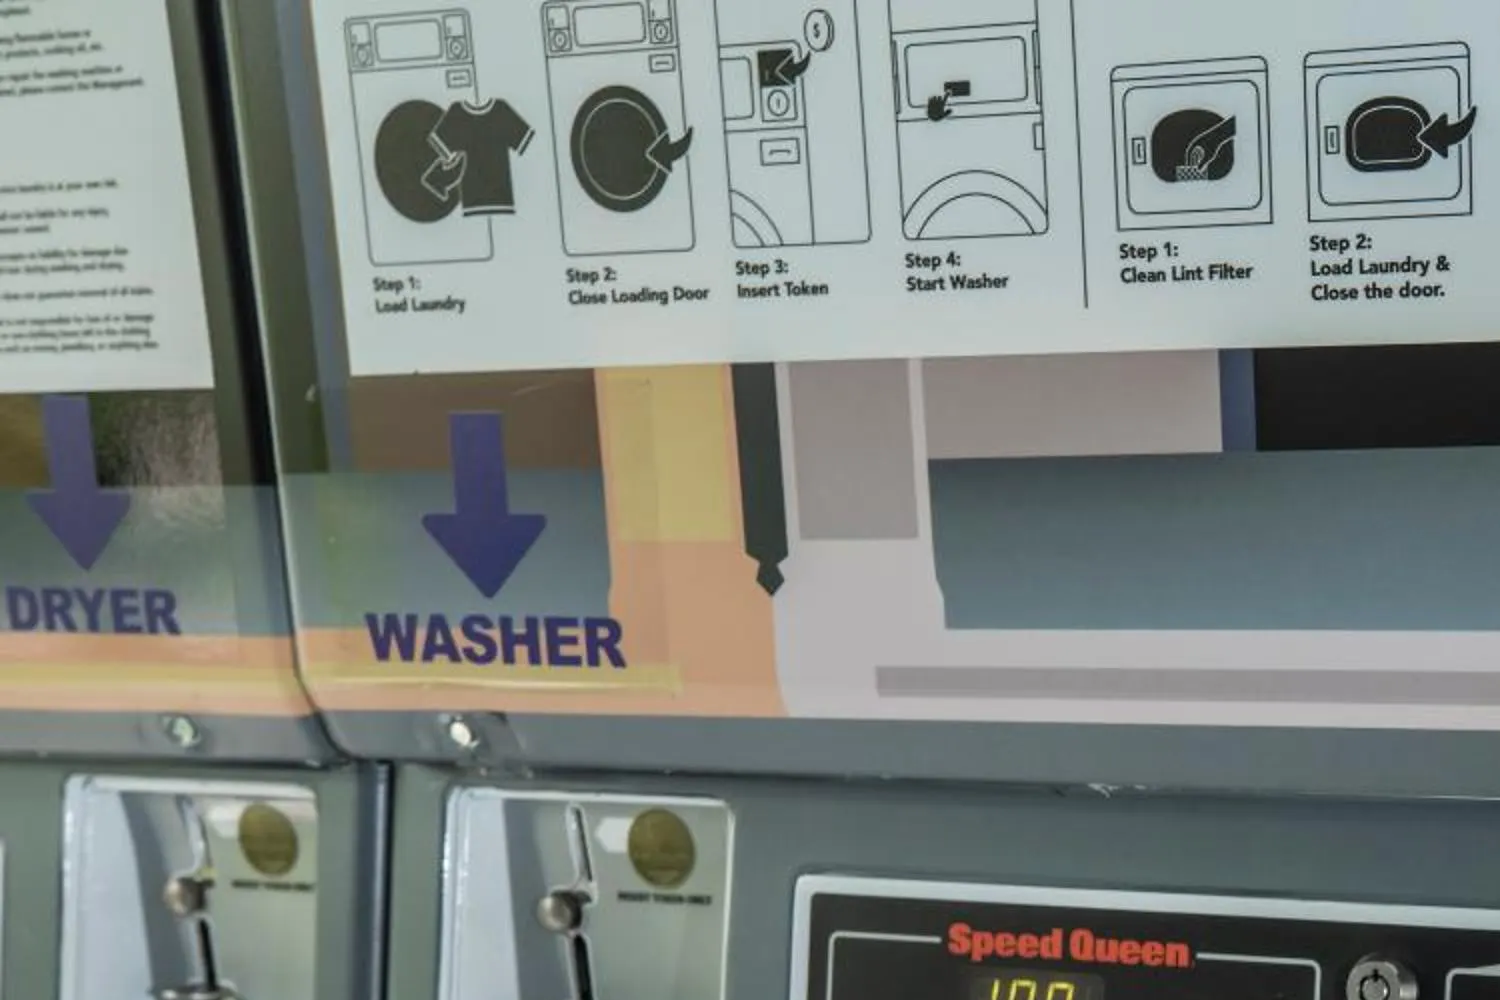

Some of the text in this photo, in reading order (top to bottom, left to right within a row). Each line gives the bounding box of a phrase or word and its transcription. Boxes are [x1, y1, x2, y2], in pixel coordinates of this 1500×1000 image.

[1119, 241, 1179, 263] Step 1:
[1309, 233, 1372, 255] Step 2:
[735, 259, 789, 279] Step 3:
[905, 251, 961, 272] Step 4:
[1310, 255, 1450, 277] Load Laundry &
[566, 266, 617, 286] Step 2:
[906, 272, 1009, 292] Start Washer
[1120, 263, 1254, 284] Clean Lint Filter
[372, 275, 420, 295] Step 1:
[568, 285, 710, 306] Close Loading Door
[737, 280, 829, 298] Insert Token
[1311, 280, 1445, 301] Close the door.
[375, 295, 466, 314] Load Laundry
[5, 585, 181, 635] DRYER
[365, 612, 626, 668] WASHER
[948, 922, 1190, 968] Speed Queen
